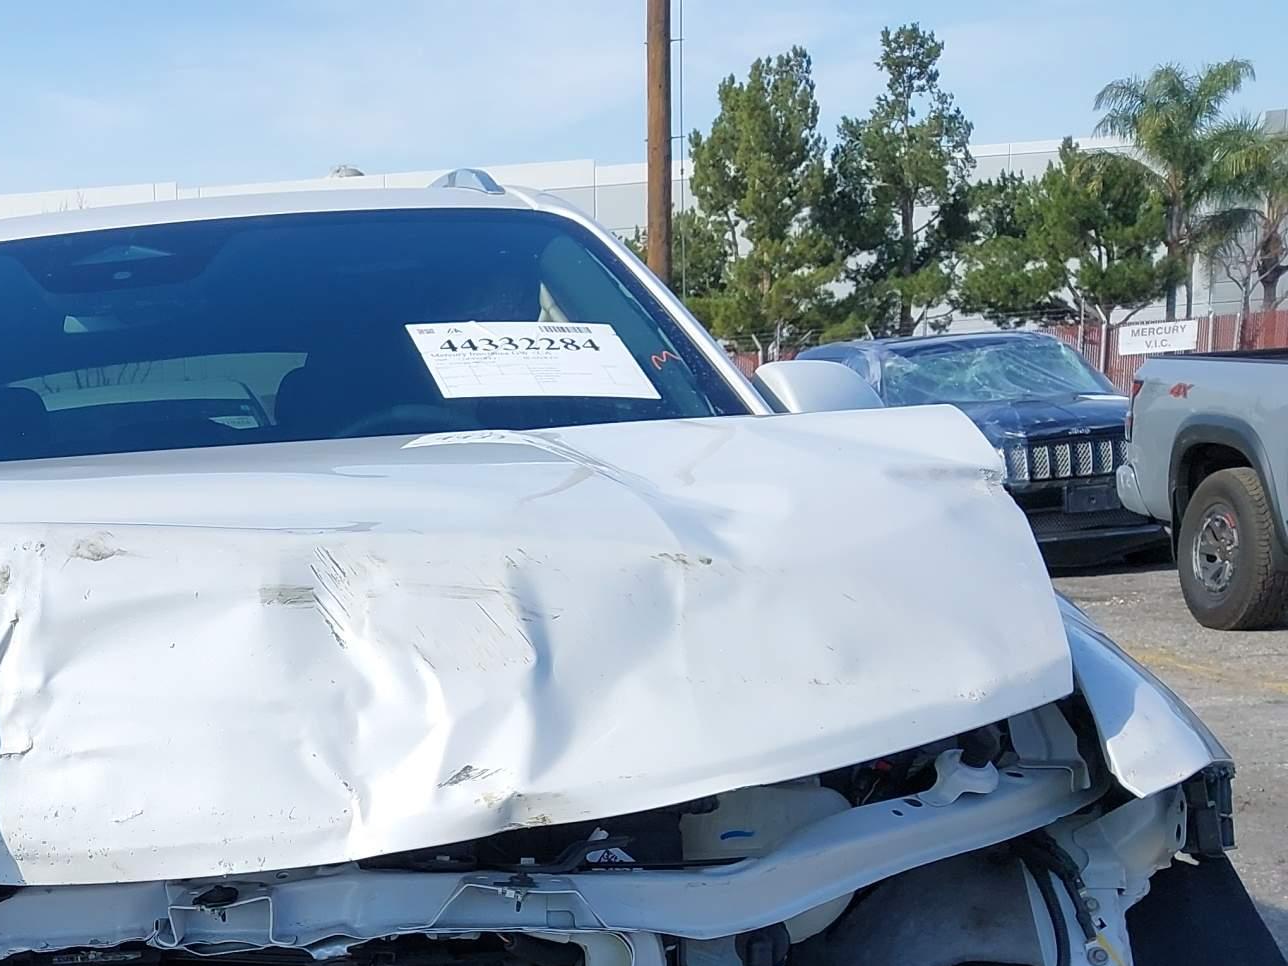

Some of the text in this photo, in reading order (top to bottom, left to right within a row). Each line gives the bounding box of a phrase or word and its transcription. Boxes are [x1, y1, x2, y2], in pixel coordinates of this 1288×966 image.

[1130, 324, 1187, 338] MERCURY
[439, 336, 601, 352] 44332284
[1144, 338, 1172, 349] V.I.C.
